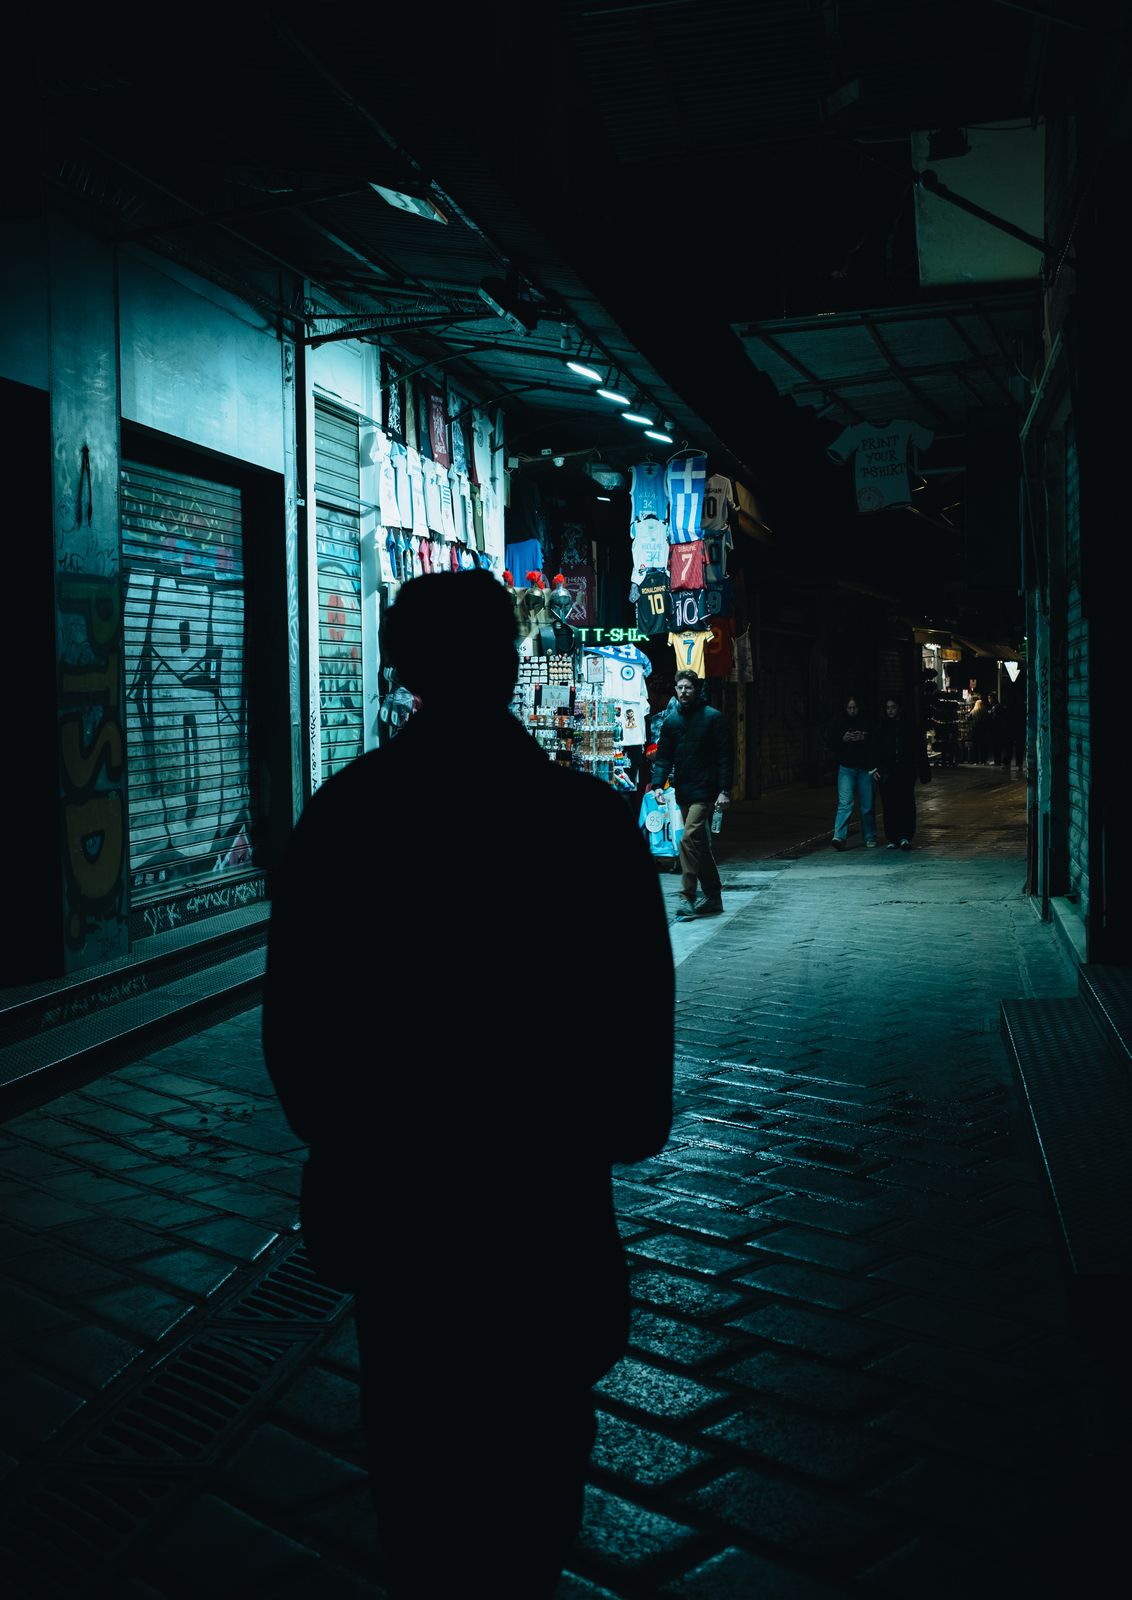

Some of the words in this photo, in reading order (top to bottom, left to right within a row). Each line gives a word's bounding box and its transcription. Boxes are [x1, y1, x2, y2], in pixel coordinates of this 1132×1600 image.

[860, 435, 900, 451] PRINT
[864, 449, 899, 464] YOUR
[681, 553, 693, 581] 7
[647, 593, 665, 616] 10
[675, 597, 699, 627] 10
[683, 639, 695, 665] 7
